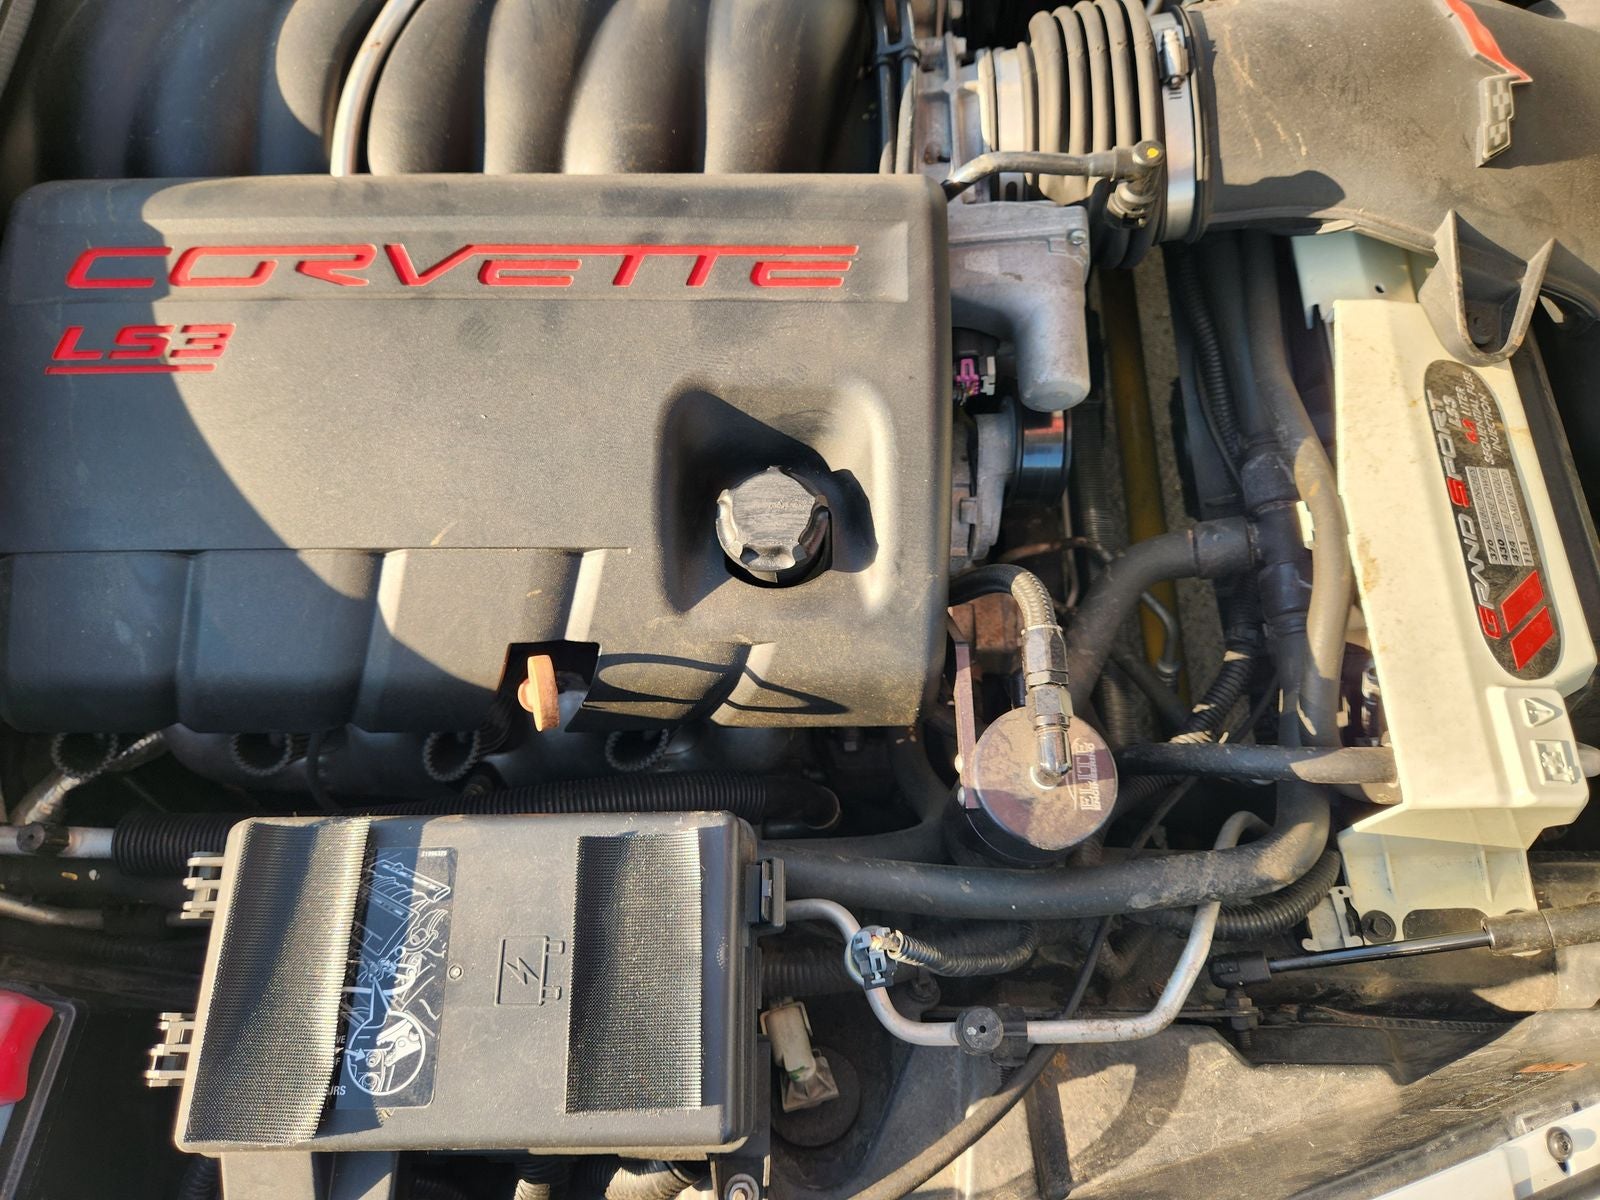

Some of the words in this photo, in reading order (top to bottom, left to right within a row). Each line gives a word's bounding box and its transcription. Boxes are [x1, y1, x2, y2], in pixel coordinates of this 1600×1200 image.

[65, 243, 860, 289] CORVETTE
[51, 323, 237, 360] LS3
[1462, 370, 1478, 396] FUEL
[1443, 394, 1463, 429] LS3
[1455, 385, 1473, 417] LITER
[1468, 399, 1496, 466] SEQUENTIAL
[1478, 392, 1503, 453] INJECTION
[1426, 388, 1471, 509] SPORT
[1469, 467, 1484, 501] INCHES
[1478, 467, 1494, 500] POWER
[1490, 470, 1507, 506] TORQUE
[1502, 470, 1515, 498] RATIO
[1477, 503, 1490, 530] CUBIC
[1488, 501, 1502, 532] HORSE
[1498, 538, 1509, 561] 430
[1509, 540, 1520, 562] 424
[1520, 540, 1533, 565] 11:1
[1457, 512, 1503, 640] GRAND
[1076, 743, 1095, 811] ELITE
